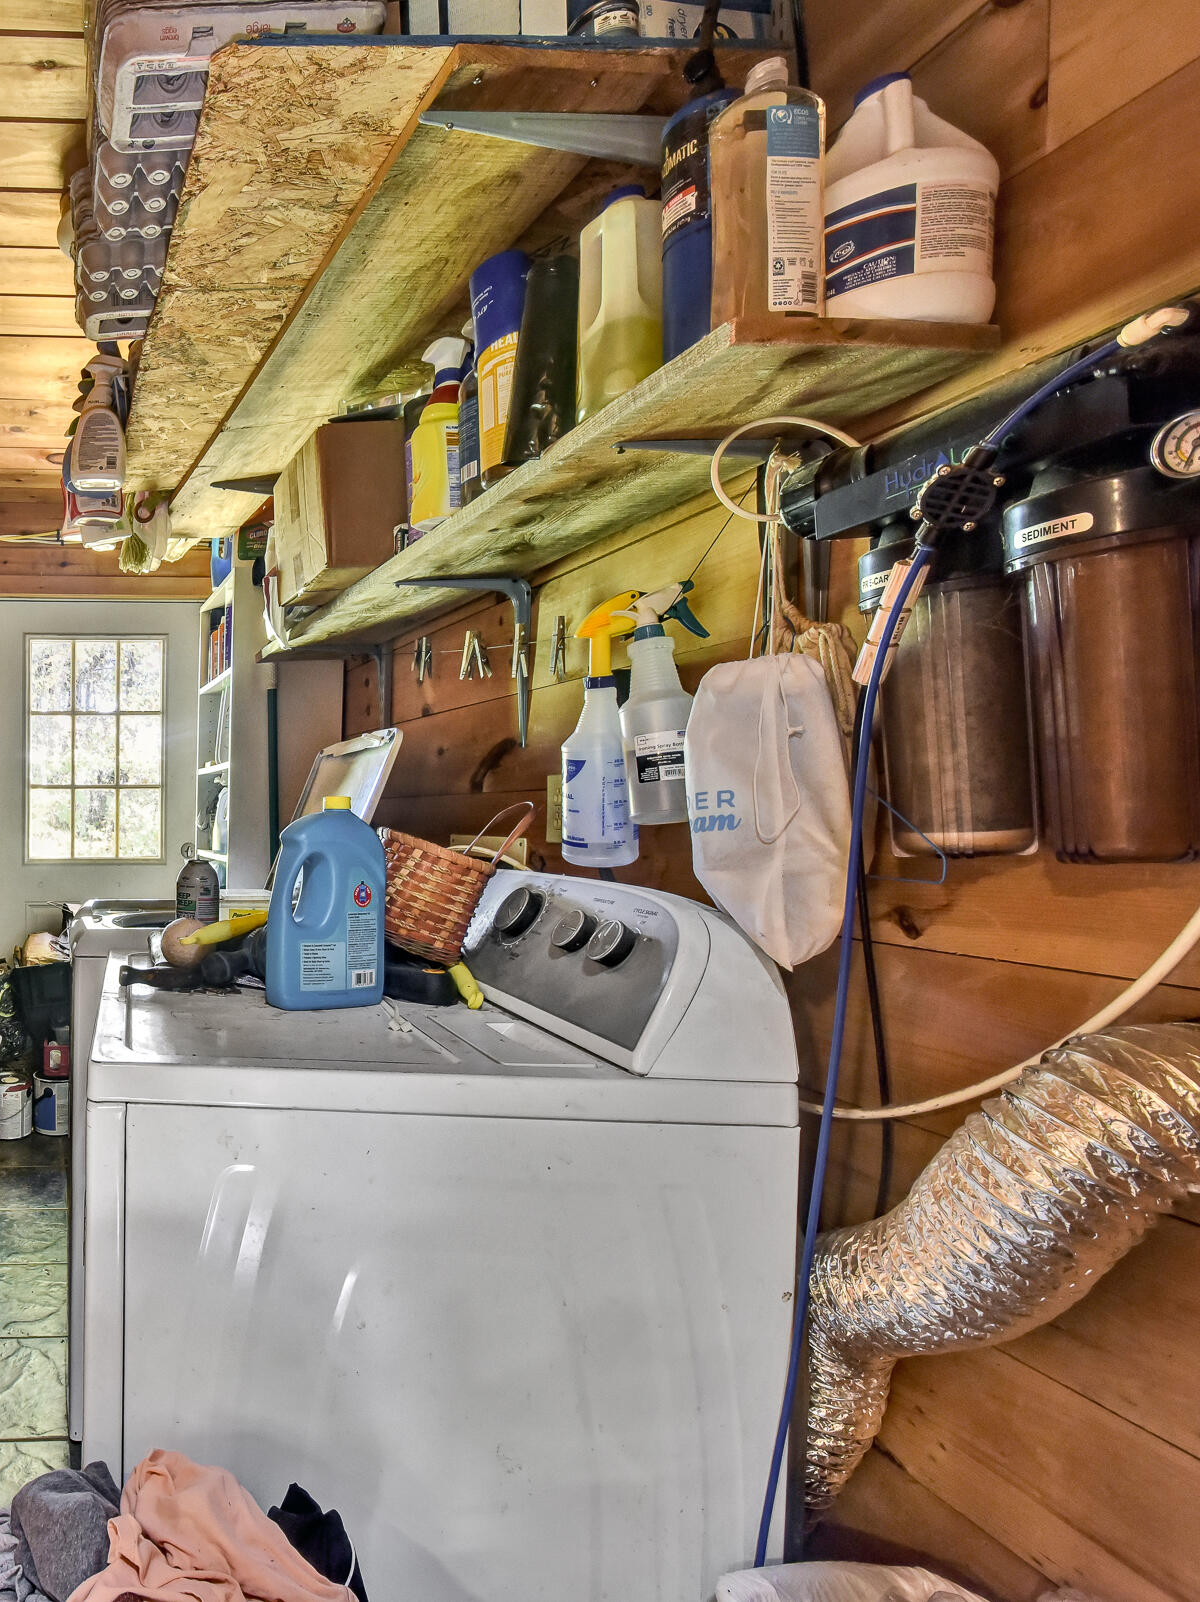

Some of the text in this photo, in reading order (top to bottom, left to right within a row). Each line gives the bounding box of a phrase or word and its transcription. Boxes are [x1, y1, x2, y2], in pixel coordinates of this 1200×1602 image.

[161, 26, 178, 34] eggs
[246, 21, 272, 34] large
[677, 8, 688, 39] dryer
[1021, 518, 1078, 543] SEDIMENT
[862, 574, 889, 590] PRE-CAR
